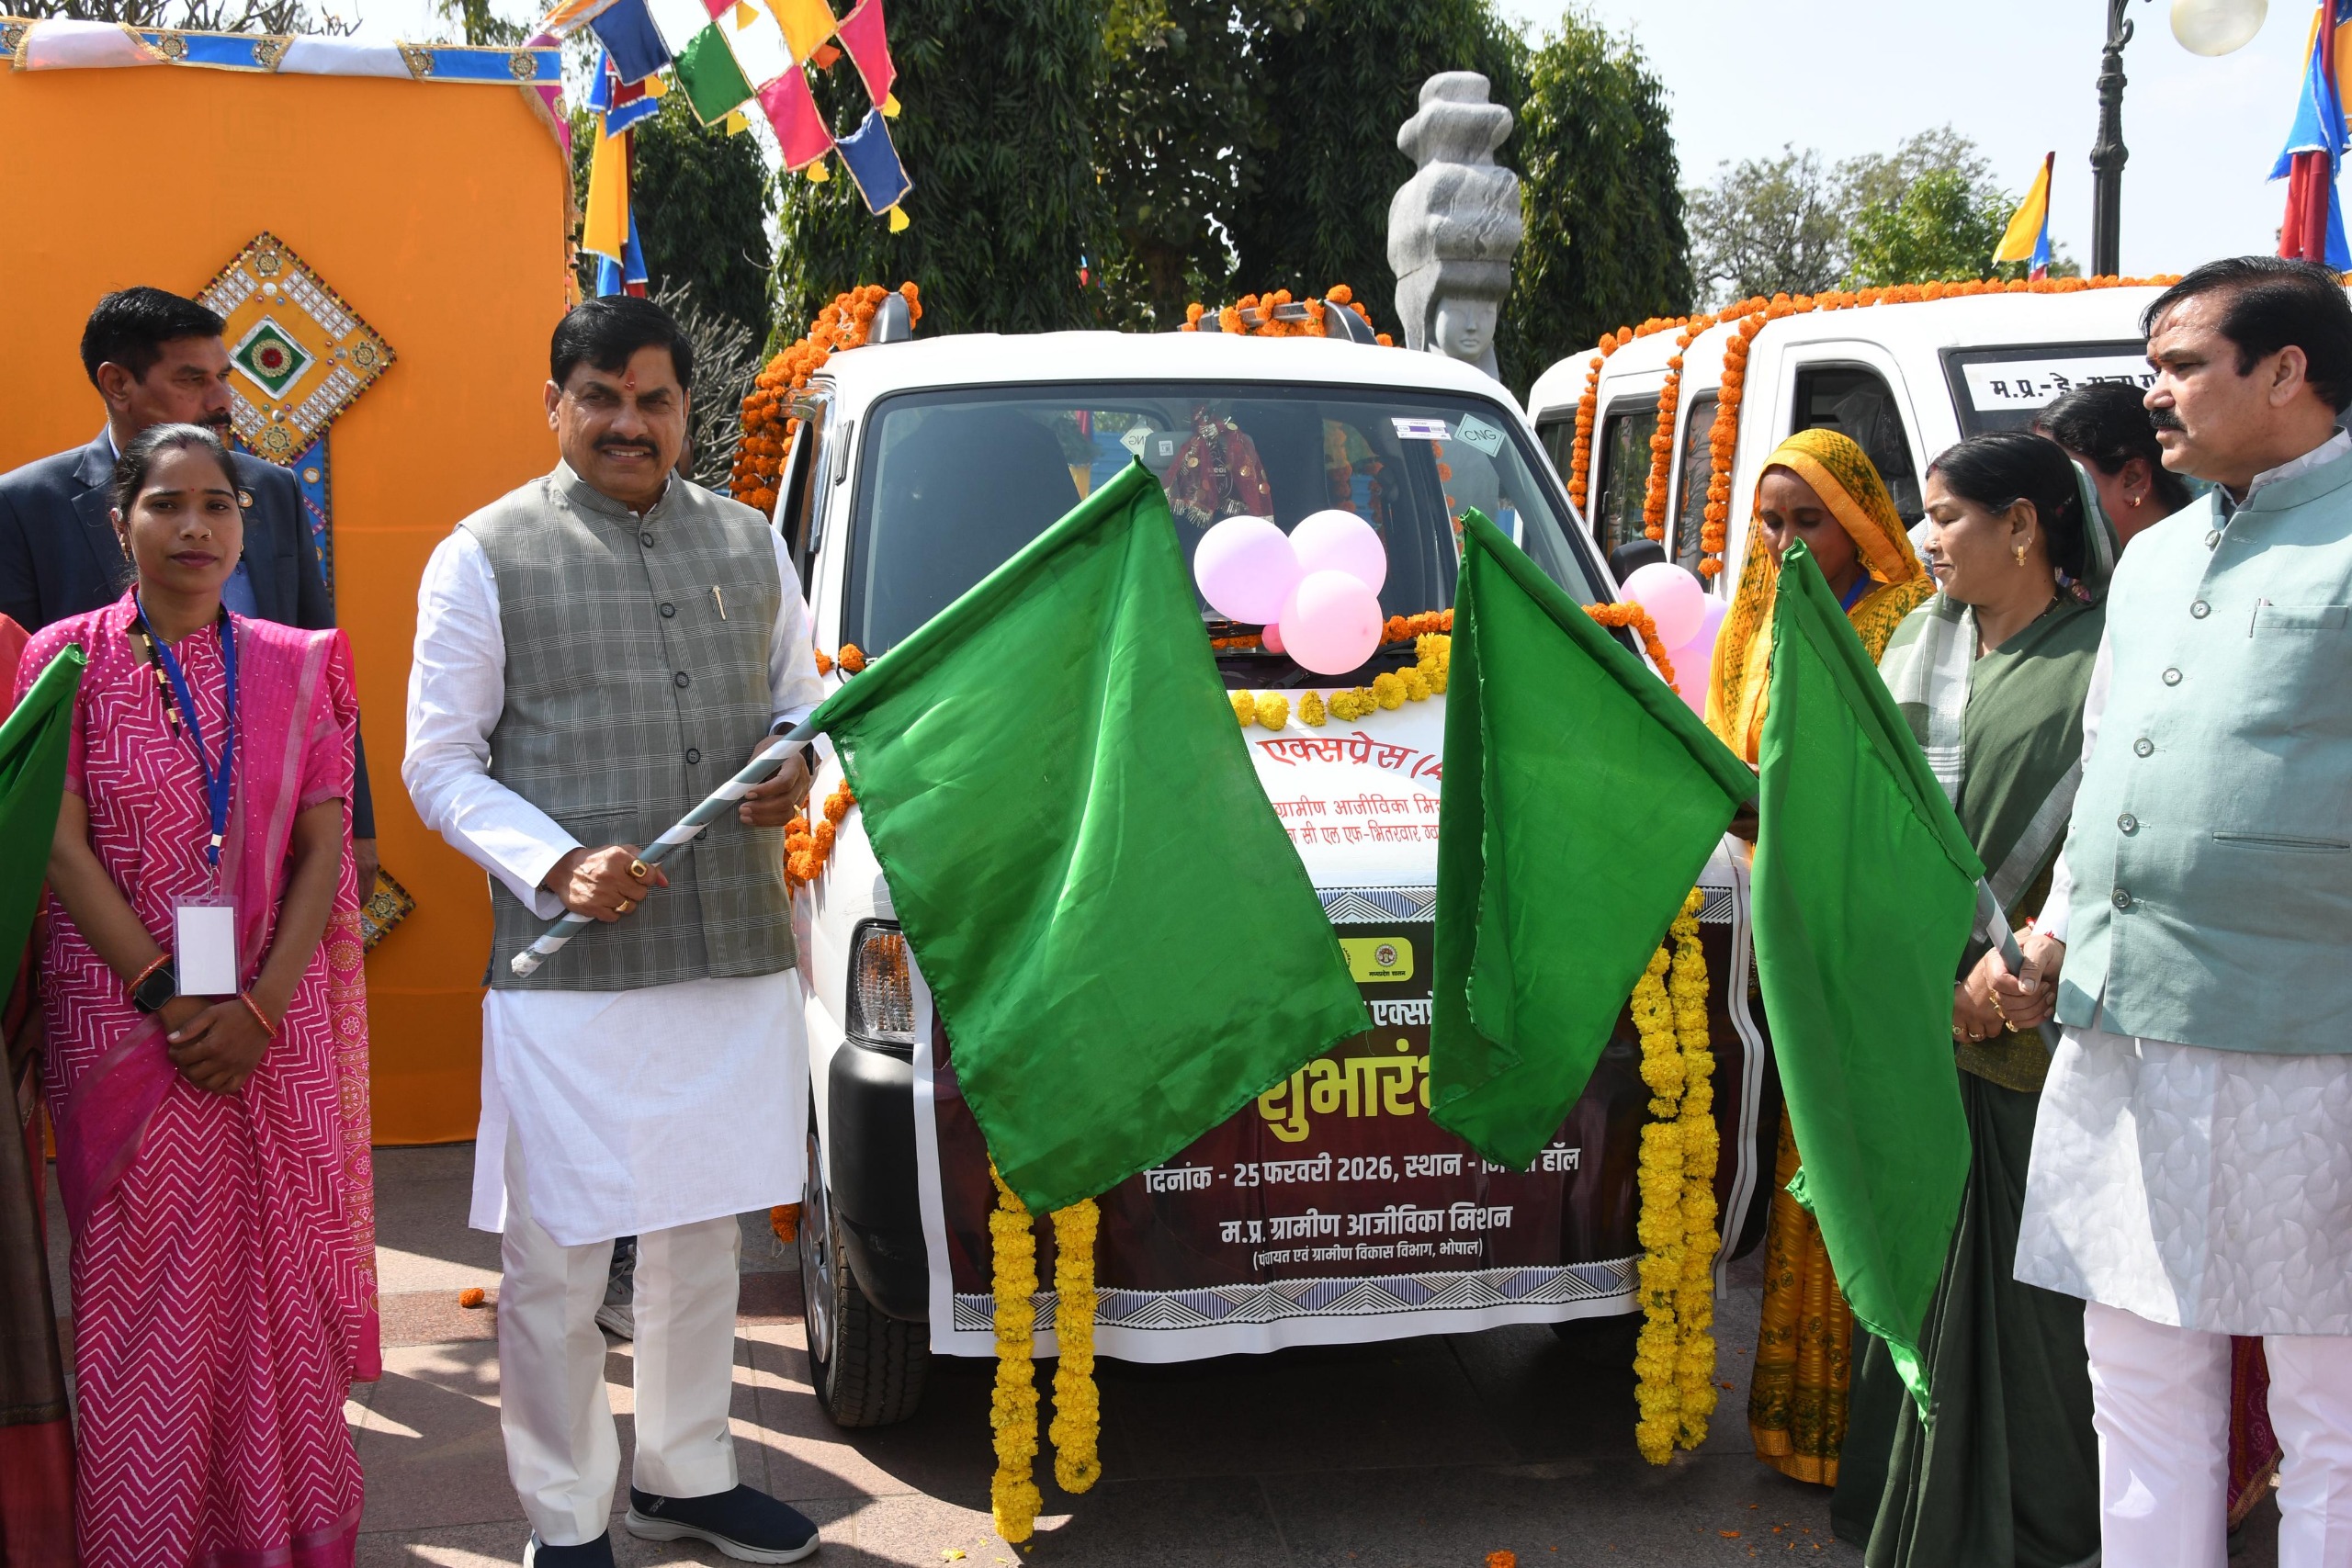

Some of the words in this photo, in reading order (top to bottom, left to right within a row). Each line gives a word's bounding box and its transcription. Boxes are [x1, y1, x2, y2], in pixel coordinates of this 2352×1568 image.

[1464, 429, 1496, 441] CNG
[1255, 731, 1419, 769] एक्सप्रेस
[1272, 795, 1327, 818] ग्रामीण
[1334, 794, 1409, 816] आजीविका
[1300, 820, 1317, 844] सी
[1320, 828, 1340, 845] एल
[1234, 1163, 1260, 1187] 25
[1262, 1152, 1332, 1184] फरवरी
[1338, 1156, 1399, 1182] 2026,
[1404, 1154, 1463, 1178] स्थान
[1541, 1142, 1581, 1171] हॉल
[1219, 1220, 1266, 1244] म.प्र.
[1270, 1208, 1341, 1240] ग्रामीण
[1347, 1204, 1445, 1236] आजीविका
[1448, 1201, 1513, 1232] मिशन
[1293, 1245, 1309, 1262] एवं
[1311, 1244, 1353, 1261] ग्रामीण
[1355, 1243, 1395, 1260] विकास
[1396, 1240, 1435, 1258] विभाग,
[1439, 1237, 1483, 1258] भोपाल)
